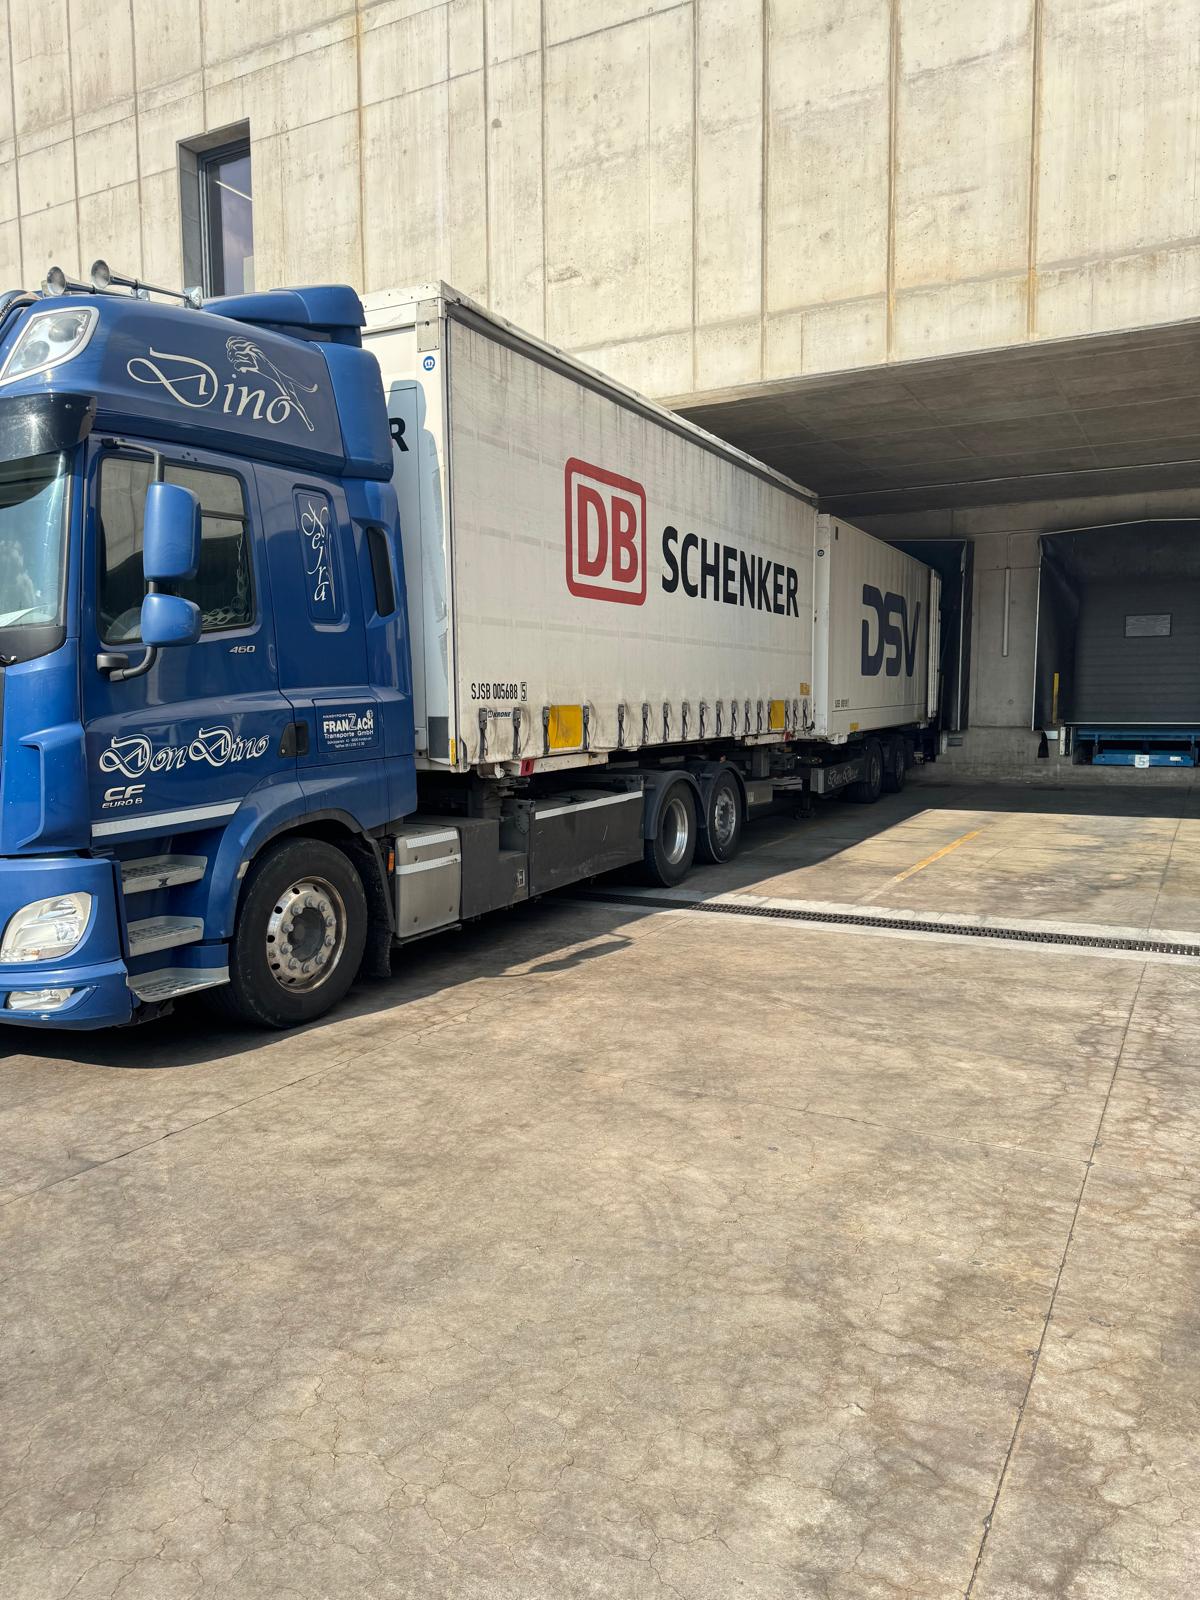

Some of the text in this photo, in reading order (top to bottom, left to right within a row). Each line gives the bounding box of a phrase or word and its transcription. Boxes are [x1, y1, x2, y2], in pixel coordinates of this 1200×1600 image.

[127, 346, 291, 424] Dino
[577, 484, 800, 618] DB SCHENKER
[861, 583, 922, 678] DSV
[229, 645, 256, 654] 460
[471, 683, 491, 700] SJSB
[492, 683, 518, 700] 005688
[99, 725, 270, 779] Don Dino
[101, 799, 134, 809] EURO
[104, 784, 146, 801] CF
